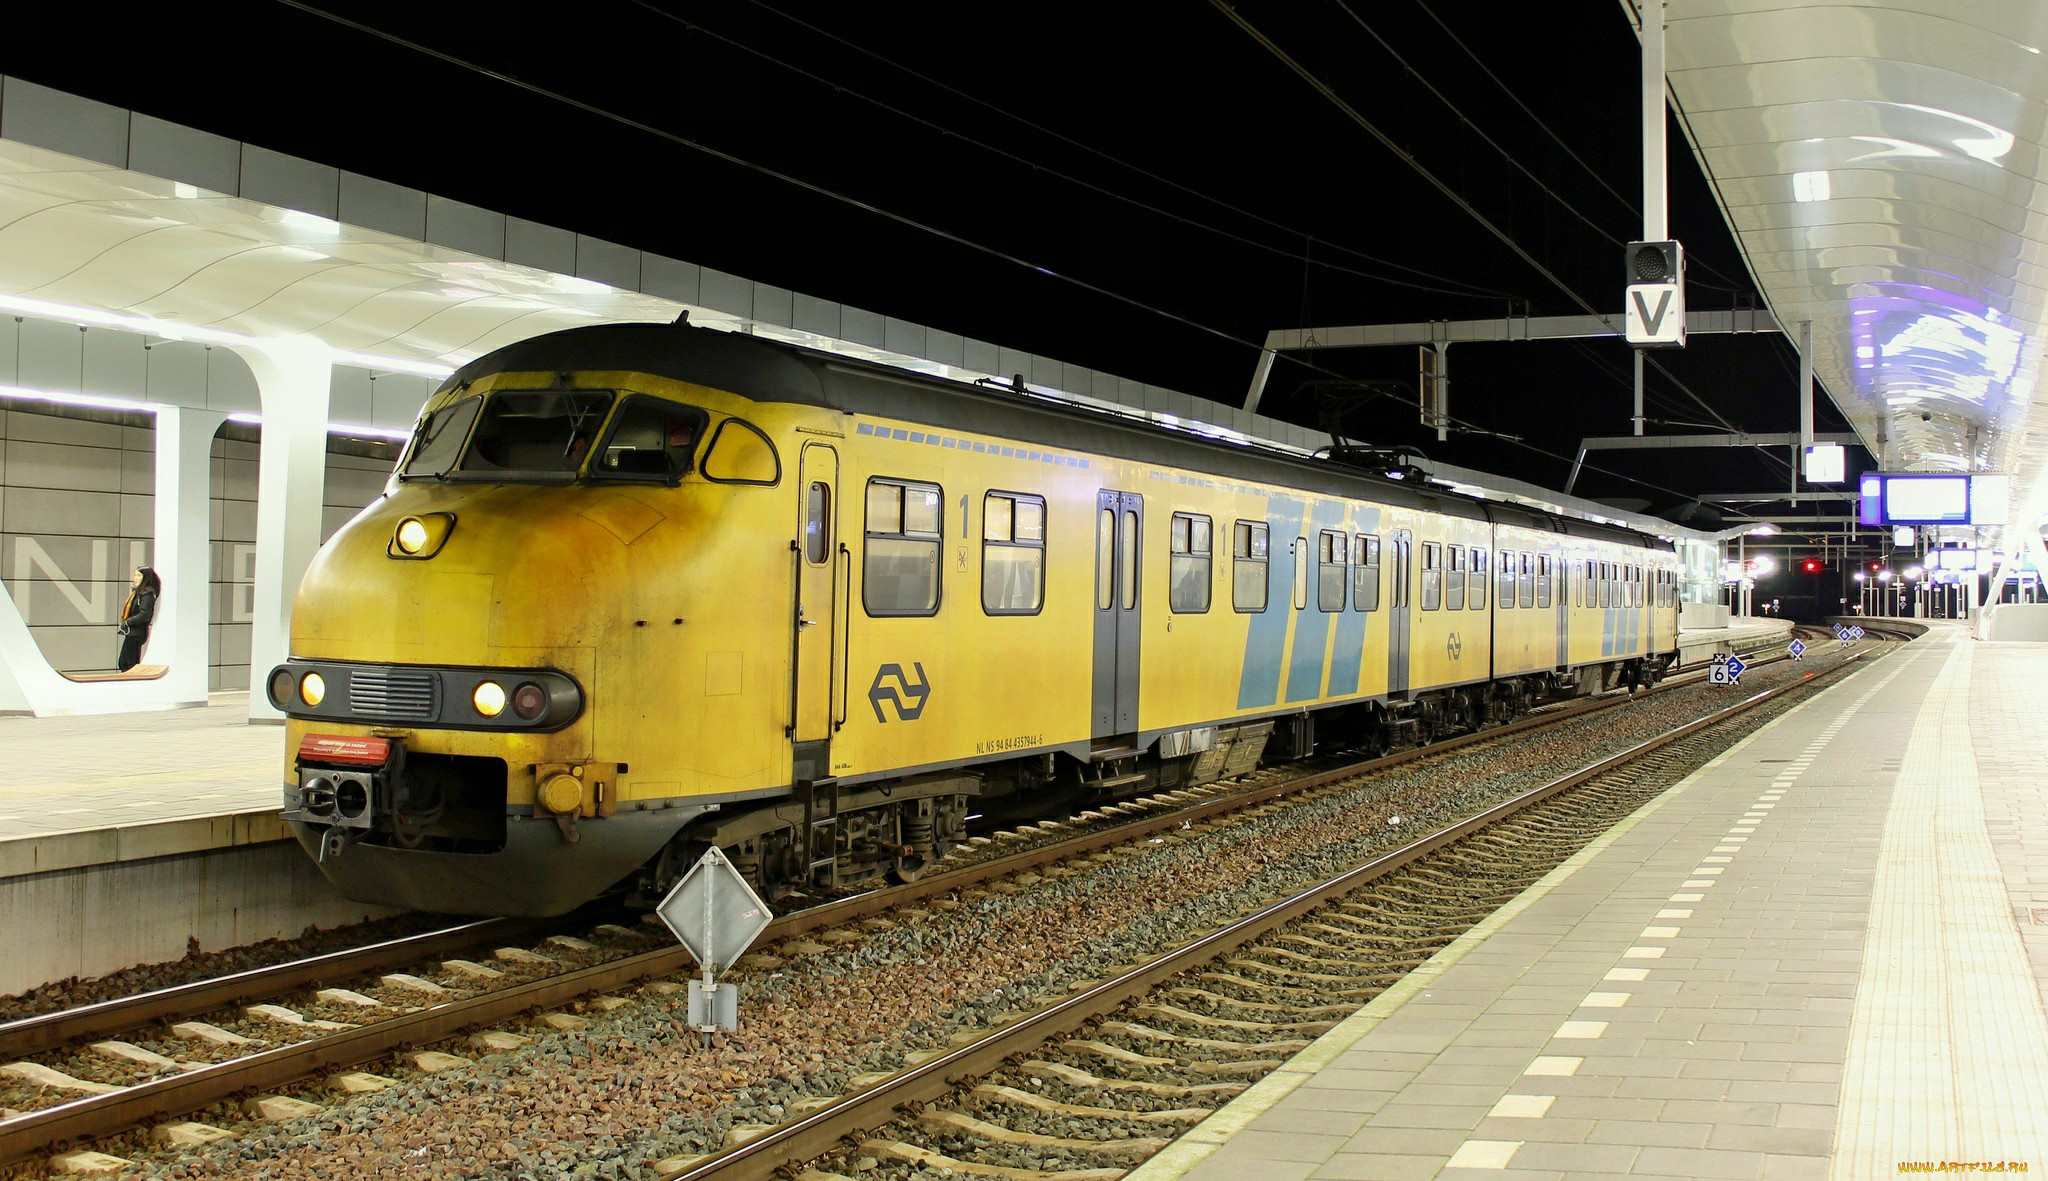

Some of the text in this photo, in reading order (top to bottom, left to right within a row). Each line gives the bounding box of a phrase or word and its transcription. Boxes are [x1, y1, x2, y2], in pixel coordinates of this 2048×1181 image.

[1631, 290, 1673, 336] V
[959, 494, 970, 539] 1
[1220, 523, 1226, 556] 1
[1714, 666, 1724, 681] 6
[1730, 662, 1739, 673] 2
[976, 743, 984, 754] NL
[986, 741, 994, 752] NS
[996, 740, 1003, 751] 94
[1004, 738, 1012, 749] 84
